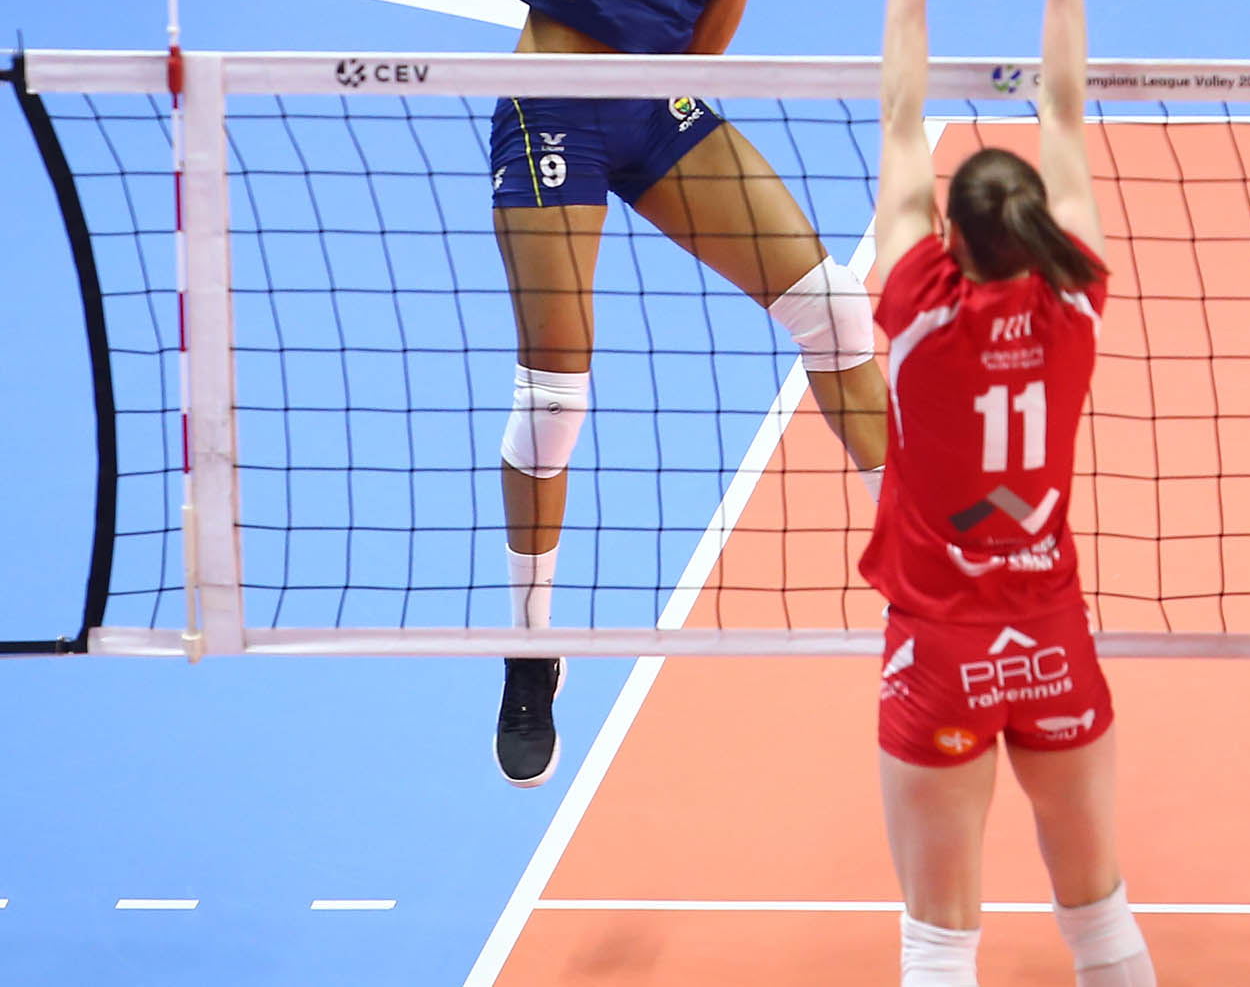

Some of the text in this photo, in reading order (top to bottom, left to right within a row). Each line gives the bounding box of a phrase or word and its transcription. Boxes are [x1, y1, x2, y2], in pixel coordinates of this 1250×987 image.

[374, 64, 429, 83] CEV
[1142, 75, 1191, 89] League
[1196, 75, 1235, 90] Volley
[538, 153, 567, 188] 9
[974, 380, 1047, 472] 11
[959, 645, 1069, 693] PRC
[967, 676, 1073, 710] rakennus
